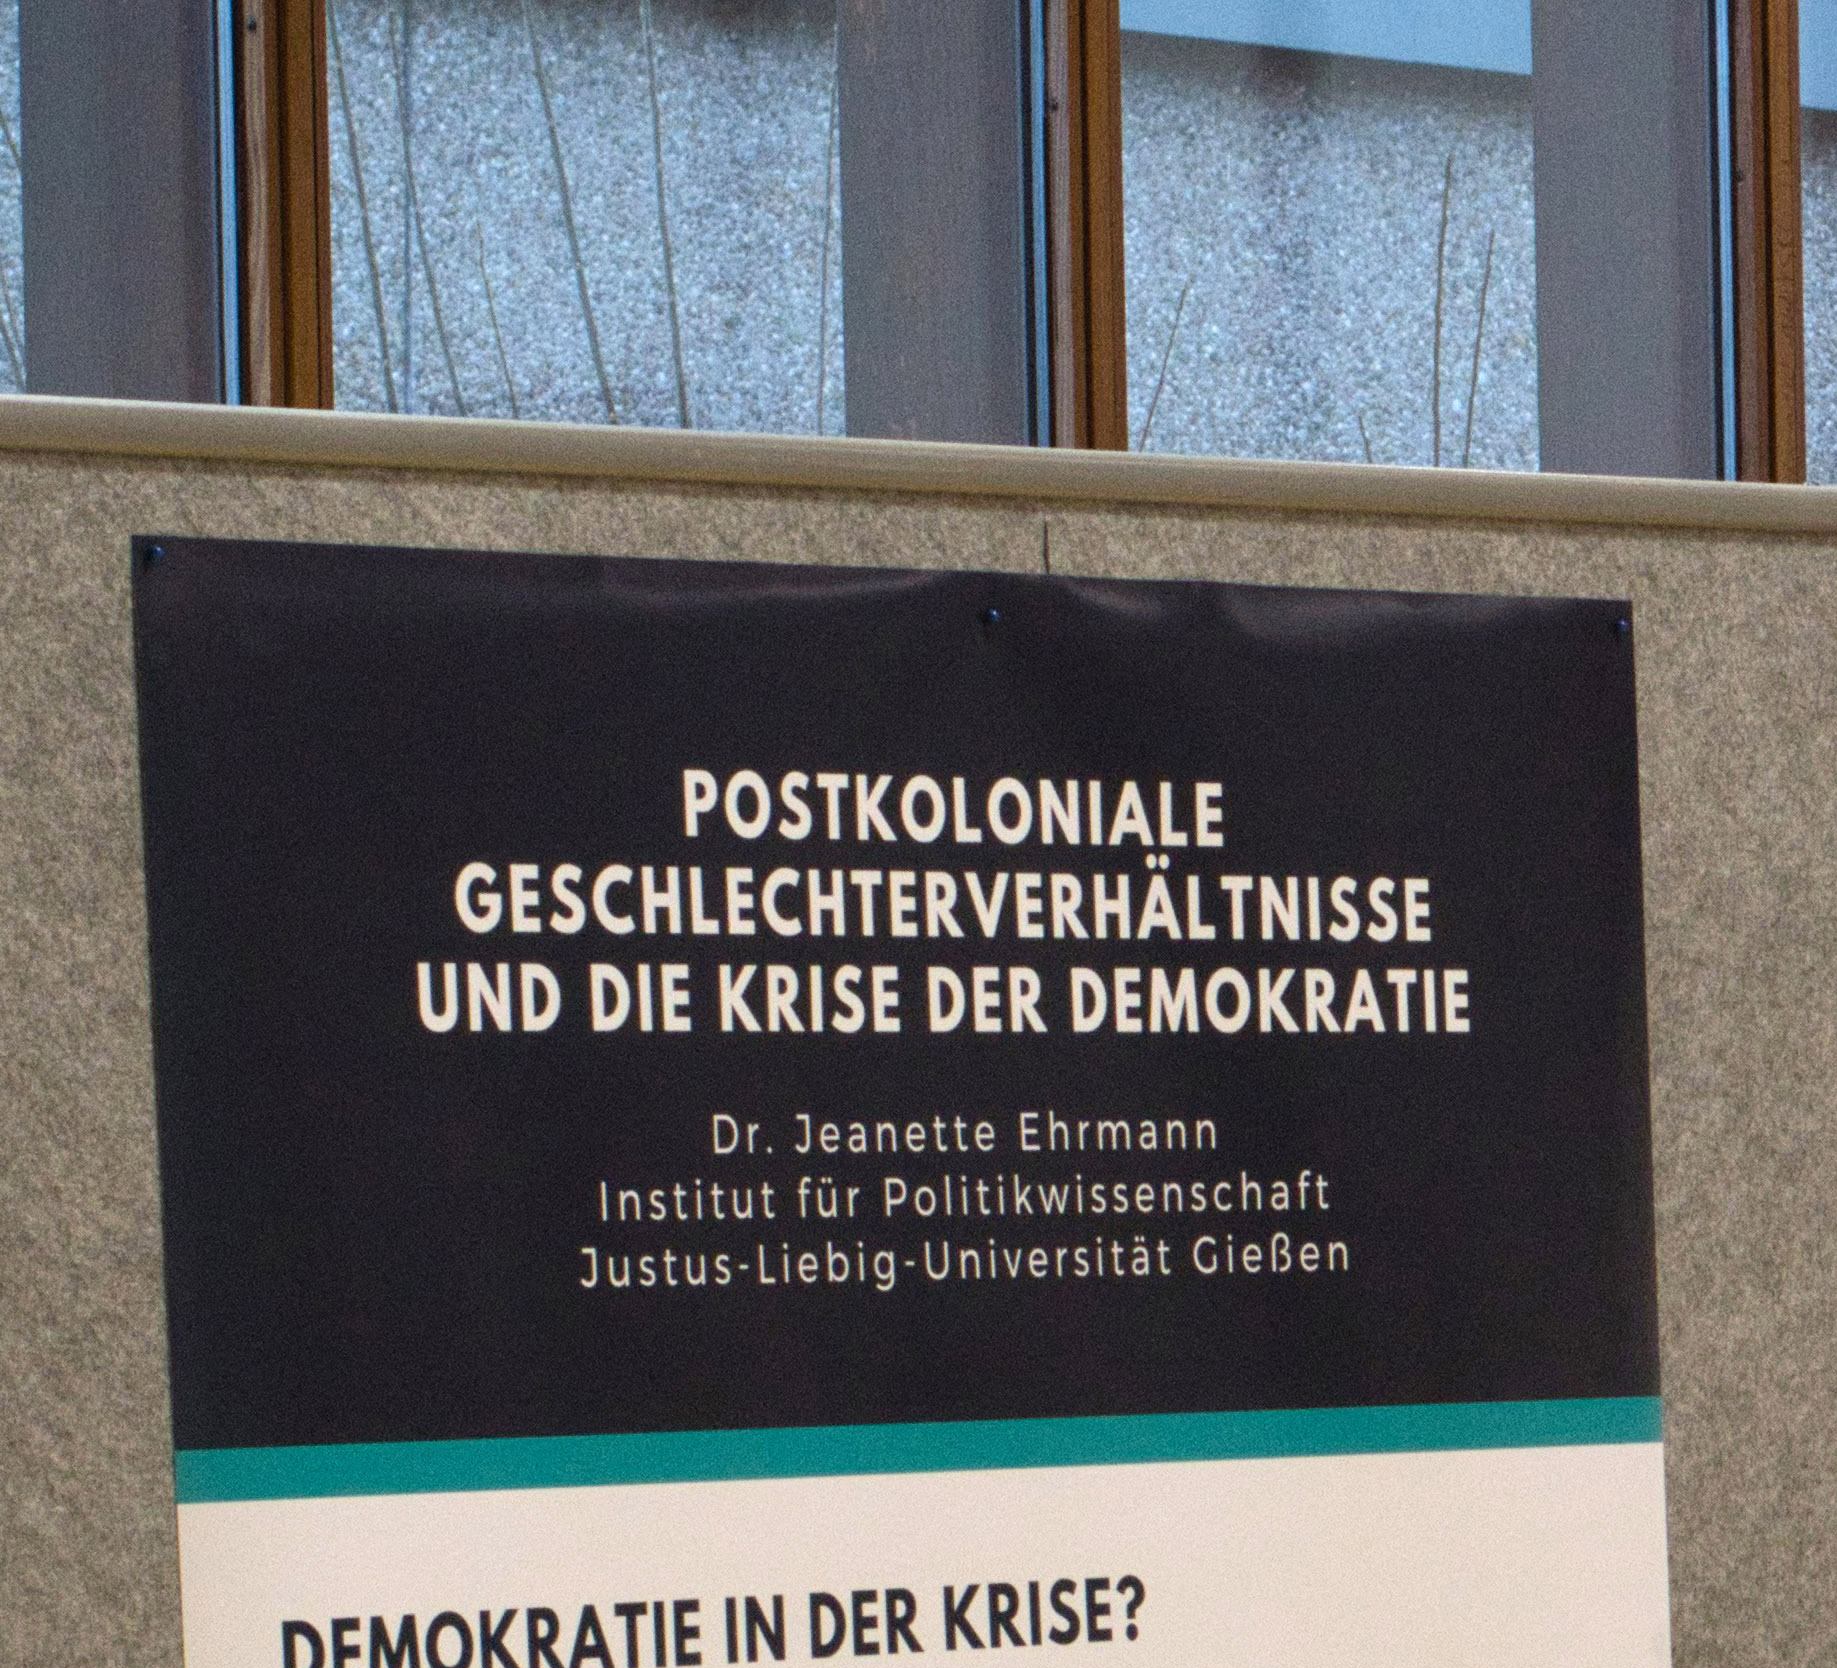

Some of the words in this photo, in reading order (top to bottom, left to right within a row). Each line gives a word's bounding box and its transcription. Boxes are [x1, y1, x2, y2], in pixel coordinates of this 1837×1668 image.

[683, 769, 1224, 847] POSTKOLONIALE
[455, 855, 1431, 942] GESCHLECHTERVERHÄLTNISSE
[417, 962, 561, 1033] UND
[590, 963, 692, 1032] DIE
[719, 964, 901, 1034] KRISE
[927, 966, 1048, 1033] DER
[1070, 966, 1470, 1034] DEMOKRATIE
[712, 1113, 773, 1155] Dr.
[795, 1113, 995, 1154] Jeanette
[1019, 1110, 1216, 1152] Ehrmann
[600, 1178, 776, 1222] Institut
[797, 1175, 860, 1219] für
[884, 1169, 1330, 1217] Politikwissenschaft
[580, 1235, 1171, 1292] Justus-Liebig-Universität
[1192, 1231, 1349, 1275] Gießen
[725, 1594, 786, 1664] IN
[809, 1587, 924, 1659] DER
[943, 1574, 1145, 1651] KRISE?
